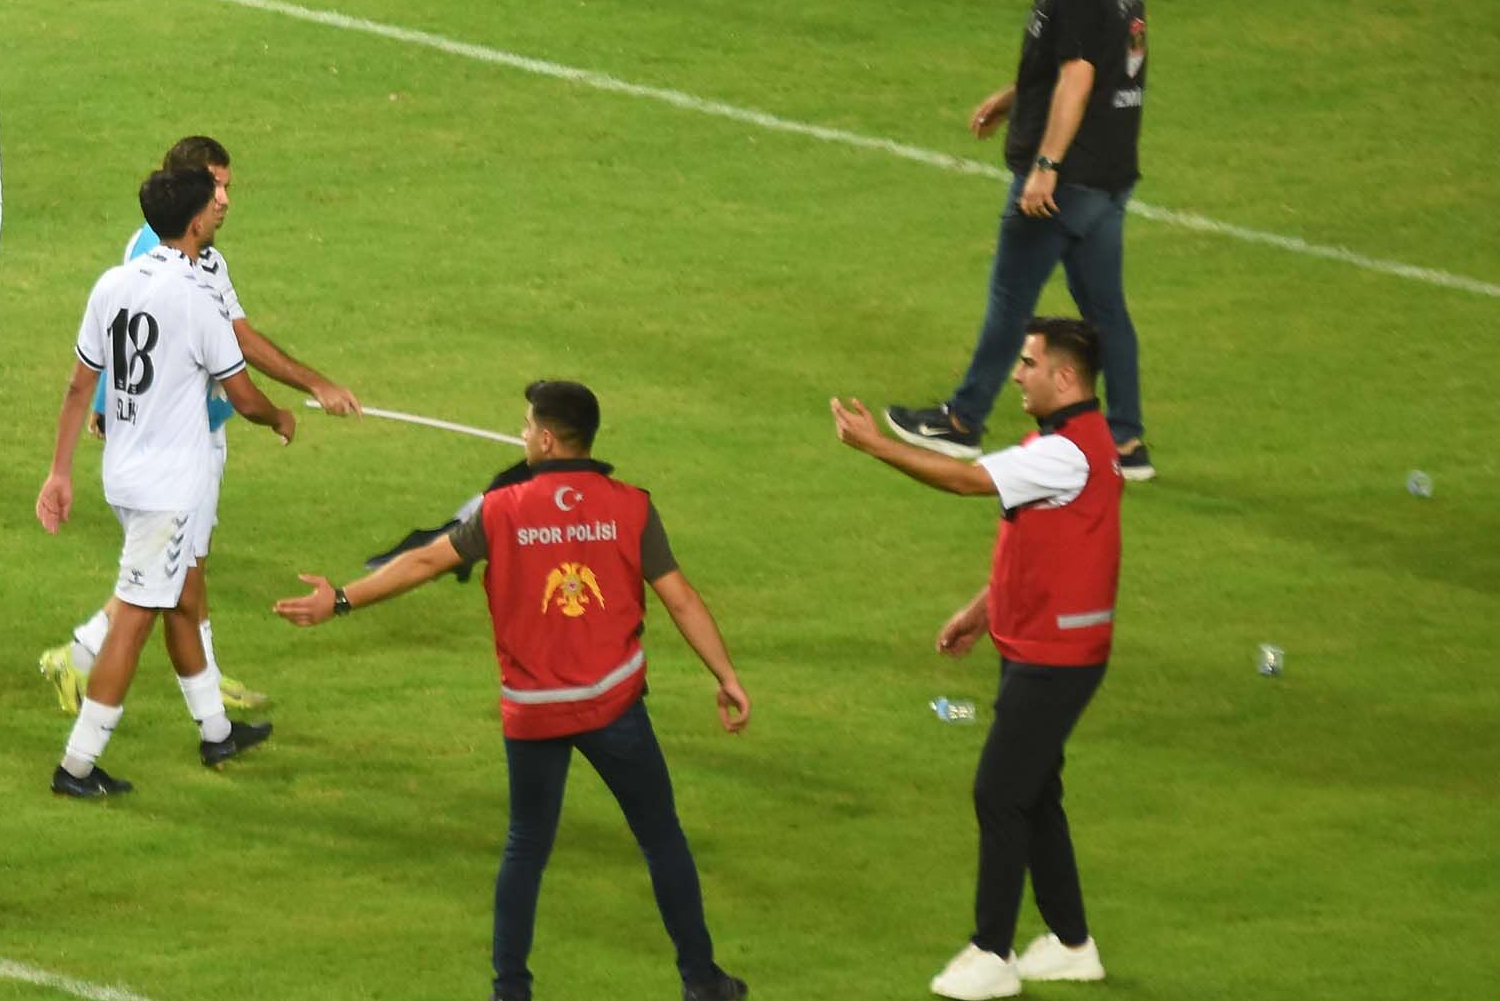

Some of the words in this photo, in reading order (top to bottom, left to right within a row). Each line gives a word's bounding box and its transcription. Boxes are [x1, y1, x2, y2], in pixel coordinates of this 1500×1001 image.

[106, 308, 160, 396] 18
[517, 525, 564, 545] SPOR
[566, 519, 618, 543] POLİSİ
